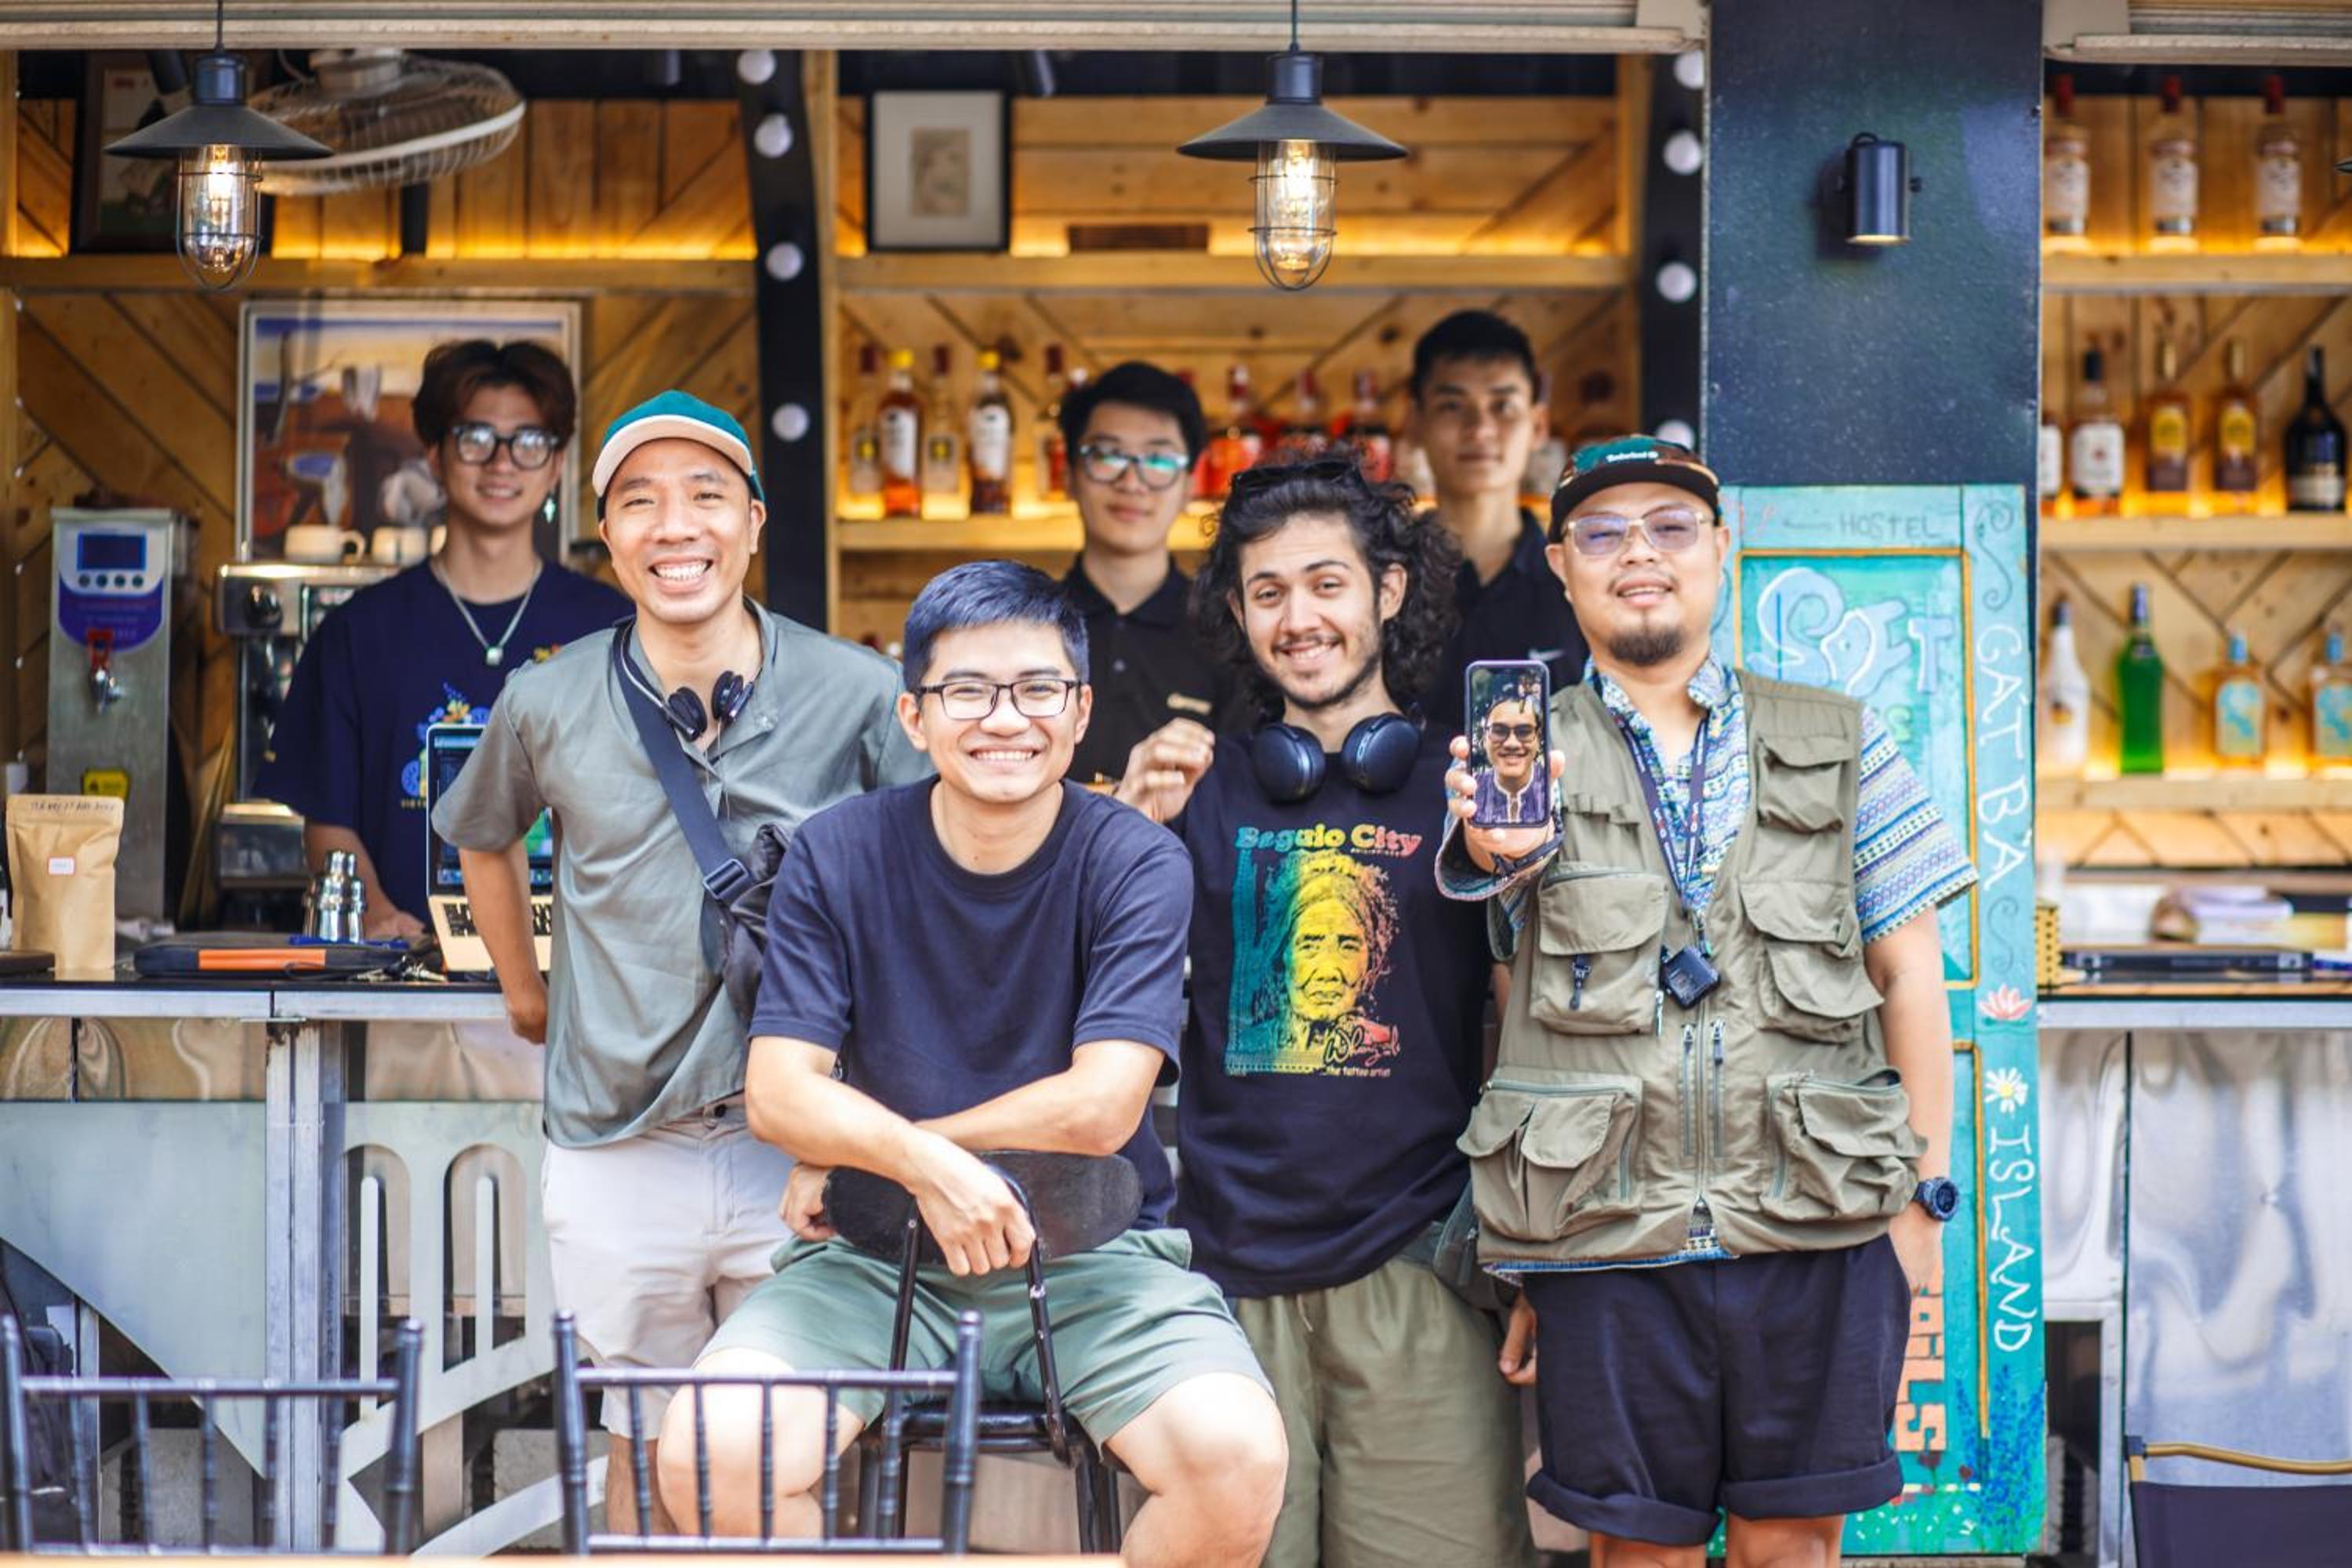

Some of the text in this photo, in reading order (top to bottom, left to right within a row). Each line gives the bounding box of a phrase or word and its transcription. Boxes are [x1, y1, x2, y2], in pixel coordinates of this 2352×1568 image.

[1838, 510, 1941, 540] HOSTEL
[1351, 824, 1422, 857] City
[1989, 1125, 2037, 1352] ISLAND
